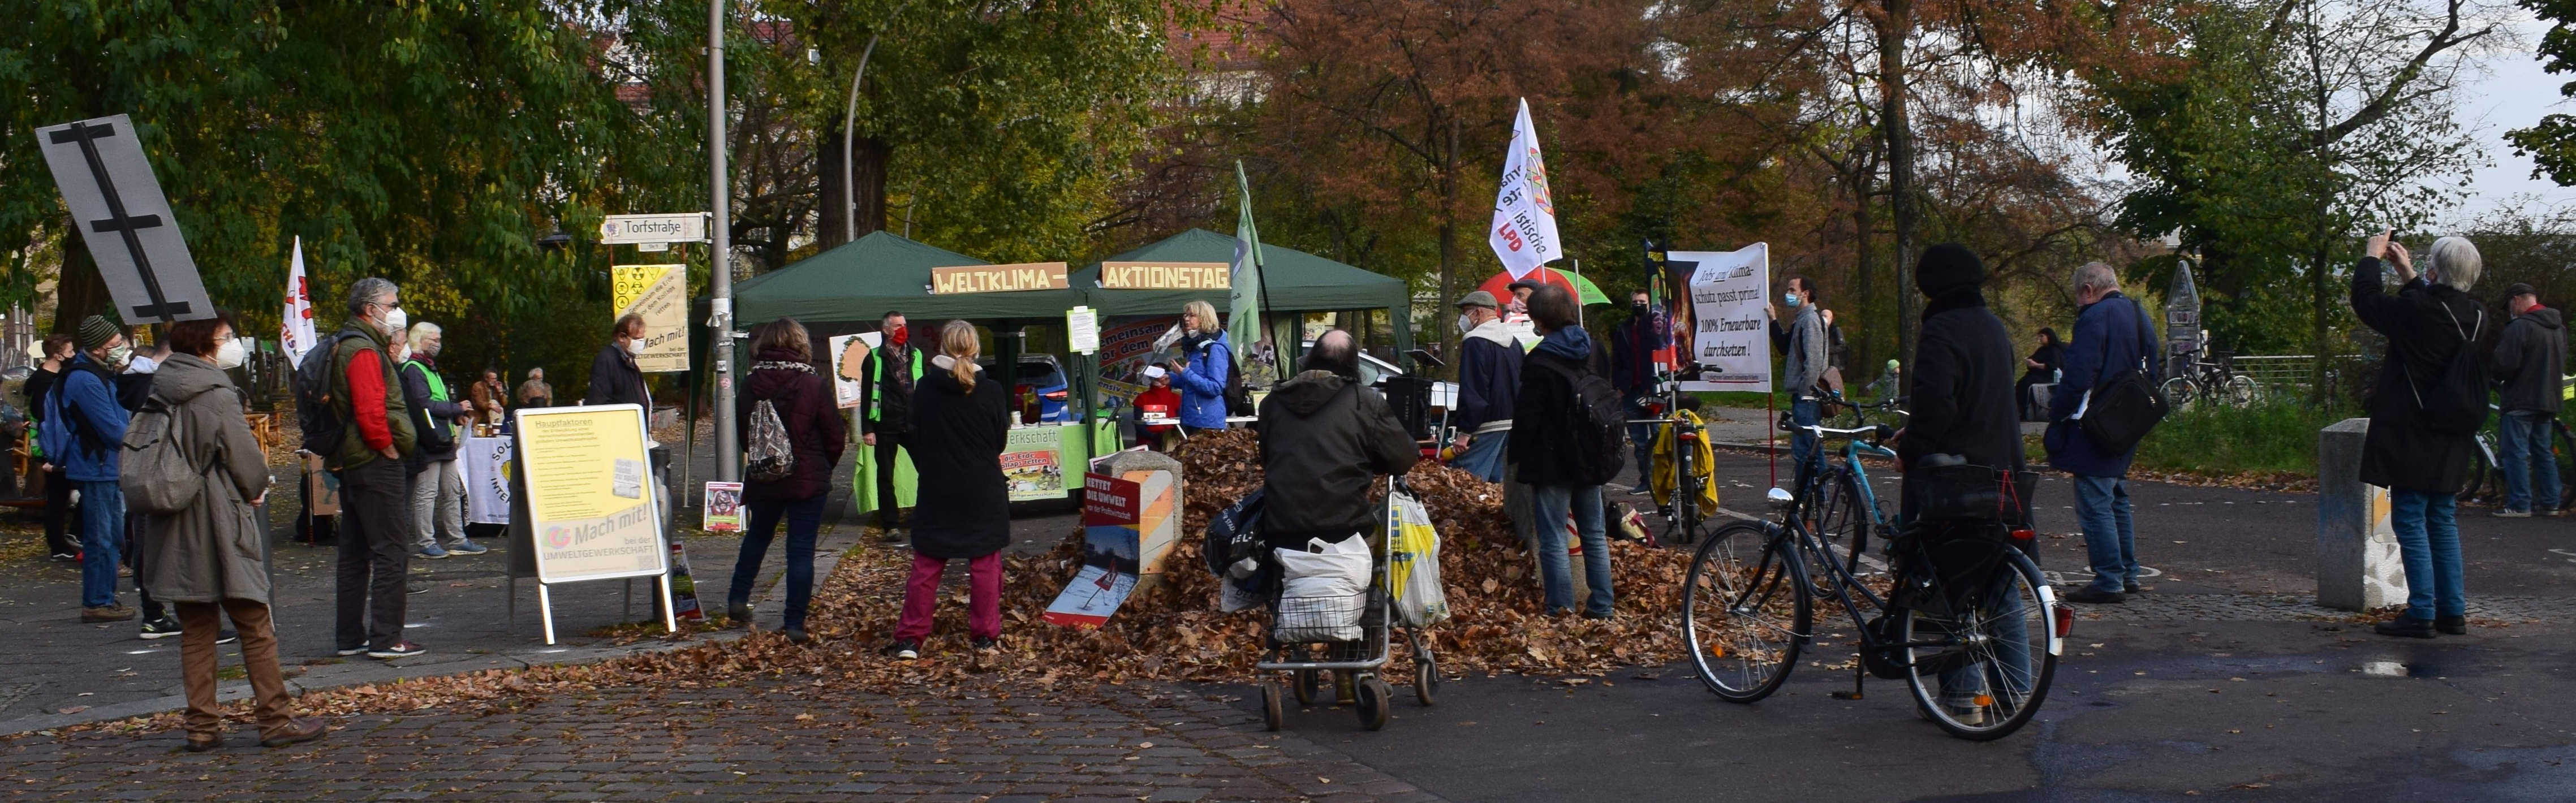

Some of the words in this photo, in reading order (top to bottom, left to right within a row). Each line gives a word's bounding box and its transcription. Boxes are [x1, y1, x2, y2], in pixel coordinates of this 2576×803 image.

[624, 219, 680, 235] Torfstraße
[1498, 222, 1523, 252] LPD
[1105, 266, 1229, 288] AKTIONSTAG
[1698, 267, 1715, 284] Jobs
[1695, 288, 1716, 304] schutz
[1717, 288, 1738, 307] passt
[1700, 319, 1718, 333] 100%
[1720, 314, 1761, 332] Erneuerbare
[667, 326, 685, 342] mit!
[1121, 340, 1149, 355] dem
[535, 418, 593, 428] Hauptfaktoren
[1086, 477, 1112, 491] RETTET
[1086, 489, 1098, 501] DIE
[1098, 491, 1126, 507] UMWELT
[575, 515, 615, 545] Mach
[619, 502, 648, 530] mit!
[544, 545, 653, 560] UMWELTGEWERKSCHAFT
